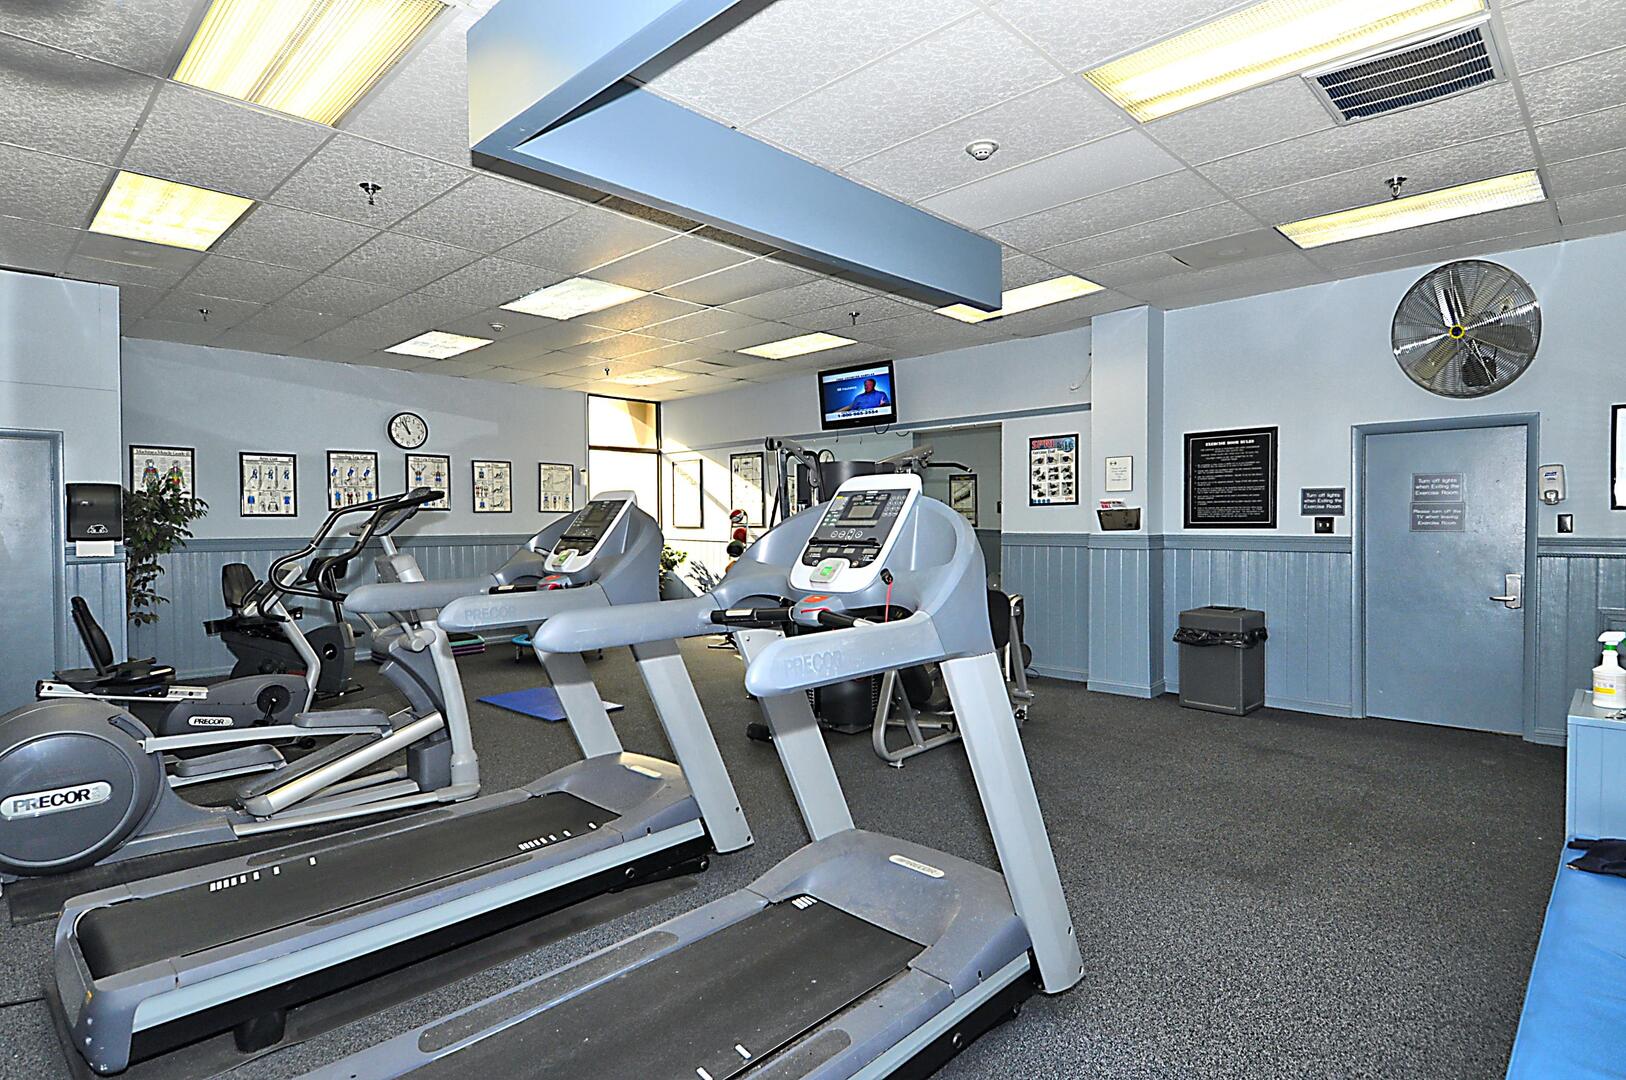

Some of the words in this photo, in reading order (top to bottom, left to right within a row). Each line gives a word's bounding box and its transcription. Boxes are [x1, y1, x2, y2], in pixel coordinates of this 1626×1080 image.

[464, 605, 516, 621] PRECOR
[784, 650, 842, 675] PRECOR
[13, 788, 91, 813] PRECOR
